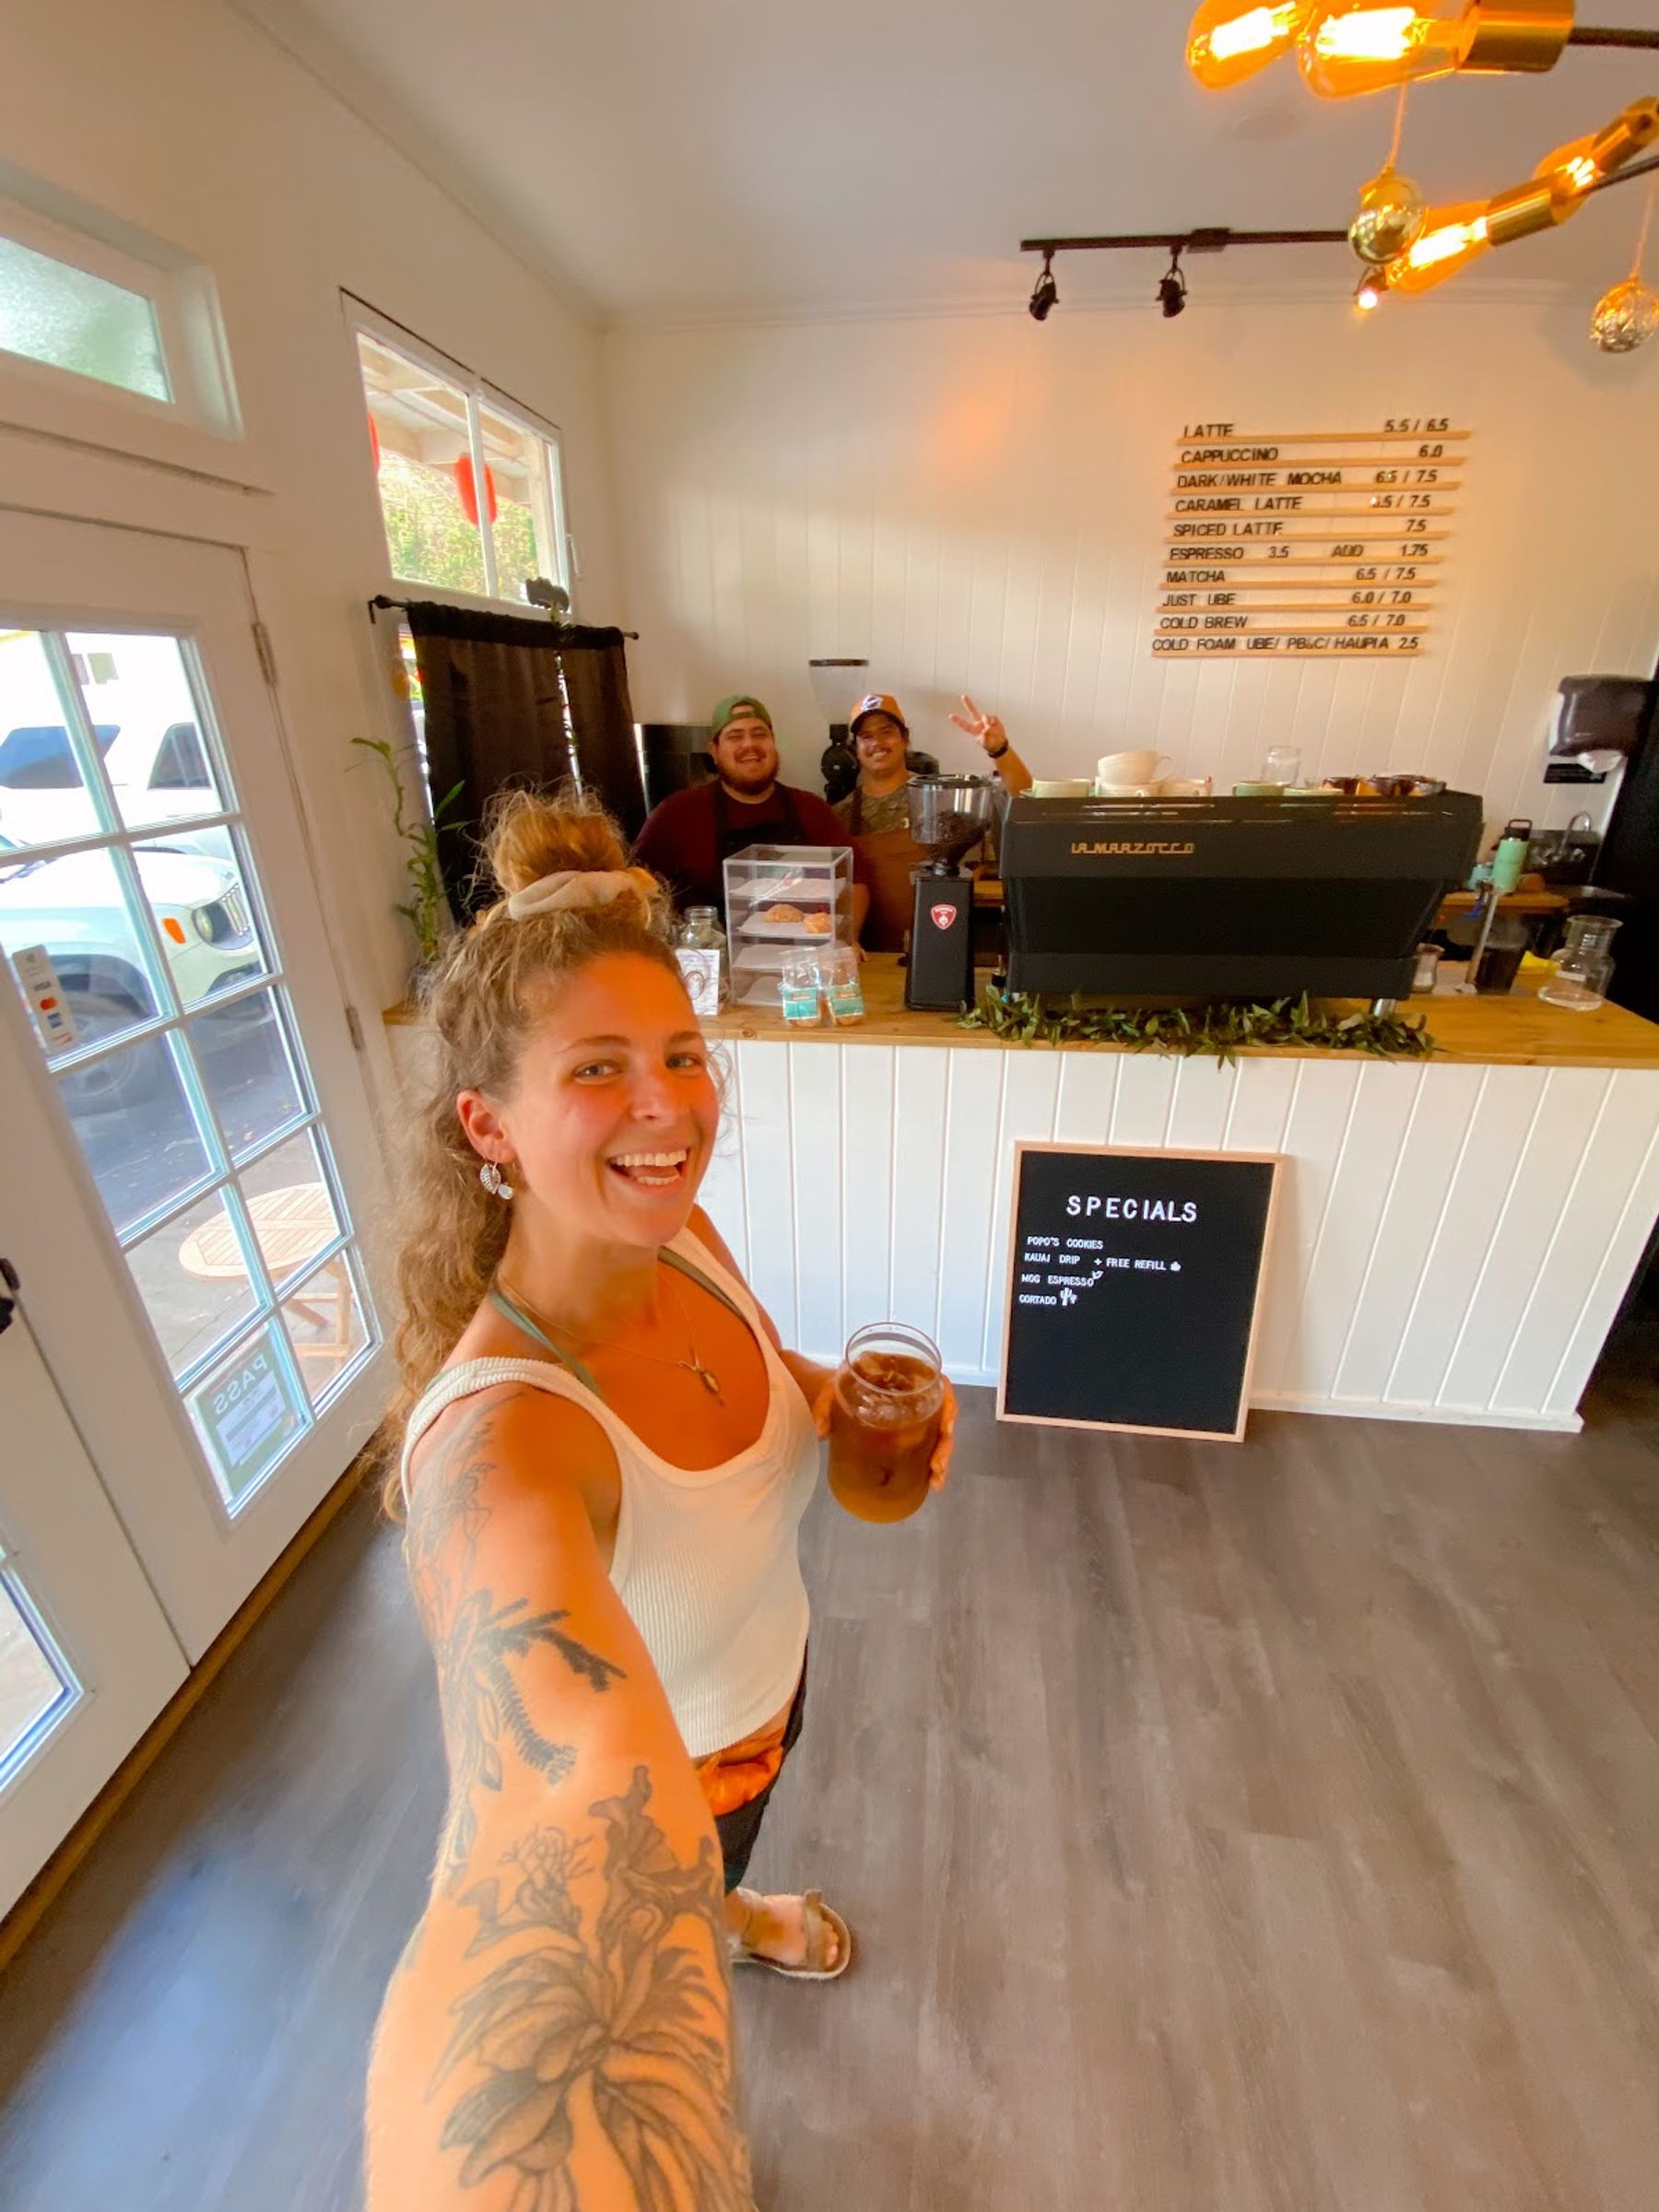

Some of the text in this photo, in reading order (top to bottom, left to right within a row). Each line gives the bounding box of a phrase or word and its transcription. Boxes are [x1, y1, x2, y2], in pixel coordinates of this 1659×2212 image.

[1183, 424, 1234, 438] LATTE
[1384, 419, 1410, 433] 5.5
[1427, 418, 1449, 432] 6.5
[1182, 444, 1443, 464] CAPPUCCINO 6.0
[1178, 473, 1277, 488] DARK/WHITE
[1288, 471, 1342, 486] MOCHA
[1418, 469, 1438, 483] 7.5
[1175, 498, 1242, 512] CARAMEL
[1255, 496, 1303, 511] LATTE
[1410, 495, 1431, 508] 7.5
[1173, 519, 1428, 537] SPICED LATTE 7.5
[1170, 544, 1430, 561] ESPRESSO 3.5 ADD 1.75
[1167, 570, 1227, 583] MATCHA
[1356, 568, 1377, 581] 6.5
[1397, 567, 1417, 581] 7.5
[1162, 594, 1197, 607] JUST
[1207, 593, 1237, 606] UBE
[1352, 592, 1375, 605] 6.0
[1392, 591, 1412, 605] 7.0
[1160, 616, 1199, 629] COLD
[1205, 616, 1248, 629] BREW
[1348, 615, 1369, 628] 6.5
[1386, 614, 1406, 627] 7.0
[1152, 639, 1190, 652] COLD
[1197, 638, 1237, 651] FOAM
[1400, 636, 1420, 649] 2.5
[1071, 842, 1088, 854] LA
[1066, 1195, 1197, 1222] SPECIALS
[1066, 1238, 1104, 1249] COOKIES
[1024, 1253, 1051, 1264] KAUAI
[1059, 1254, 1081, 1265] DRIP
[1106, 1257, 1130, 1268] FREE
[1135, 1259, 1167, 1270] REFILL
[1048, 1275, 1094, 1288] ESPRESSO
[1018, 1294, 1057, 1305] CORTADO
